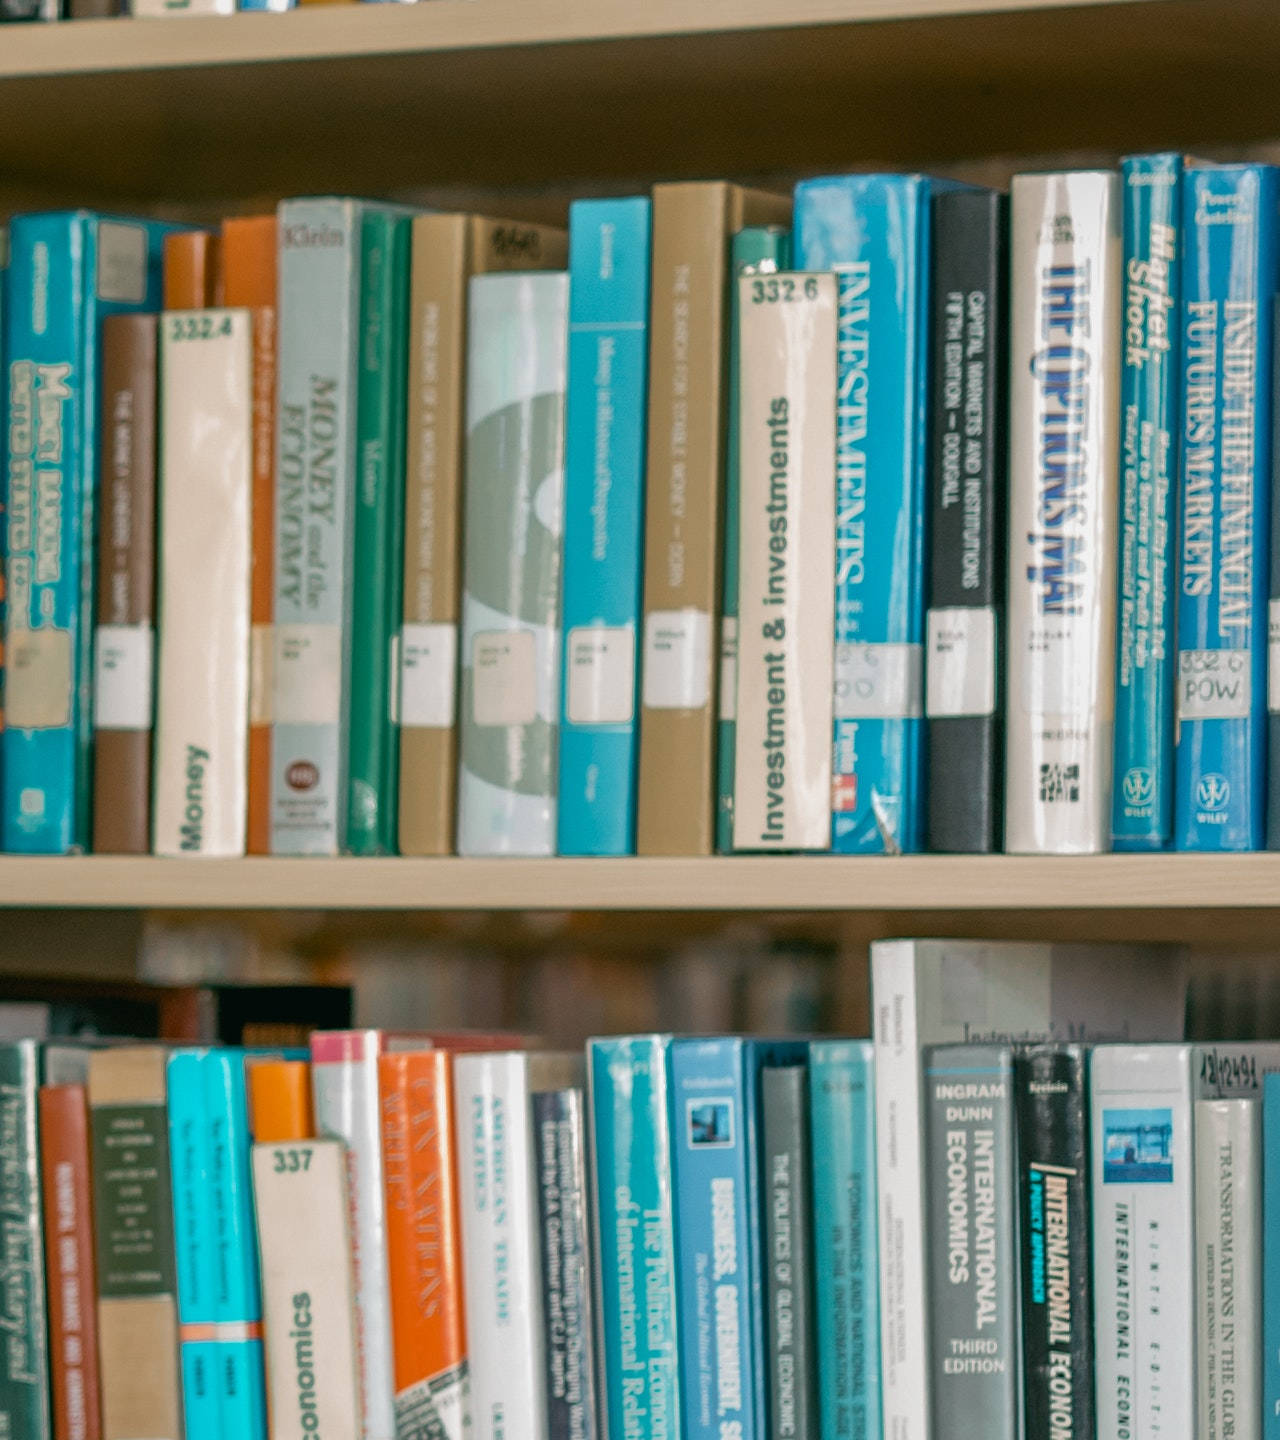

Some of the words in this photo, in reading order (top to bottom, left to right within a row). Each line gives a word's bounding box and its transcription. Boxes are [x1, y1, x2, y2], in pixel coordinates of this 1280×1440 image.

[751, 279, 819, 304] 332.6
[169, 318, 233, 340] 332.4
[763, 395, 790, 607] investments
[763, 618, 786, 642] &
[761, 653, 788, 843] Investment
[178, 745, 213, 851] Money
[935, 1083, 1006, 1100] INGRAM
[946, 1106, 993, 1123] DUNN
[272, 1150, 313, 1174] 337
[946, 1132, 969, 1284] ECONOMICS
[974, 1130, 995, 1330] INTERNATIONAL
[1044, 1171, 1073, 1347] INTERNATIONAL
[951, 1339, 999, 1356] THIRD
[944, 1359, 1004, 1374] EDITION
